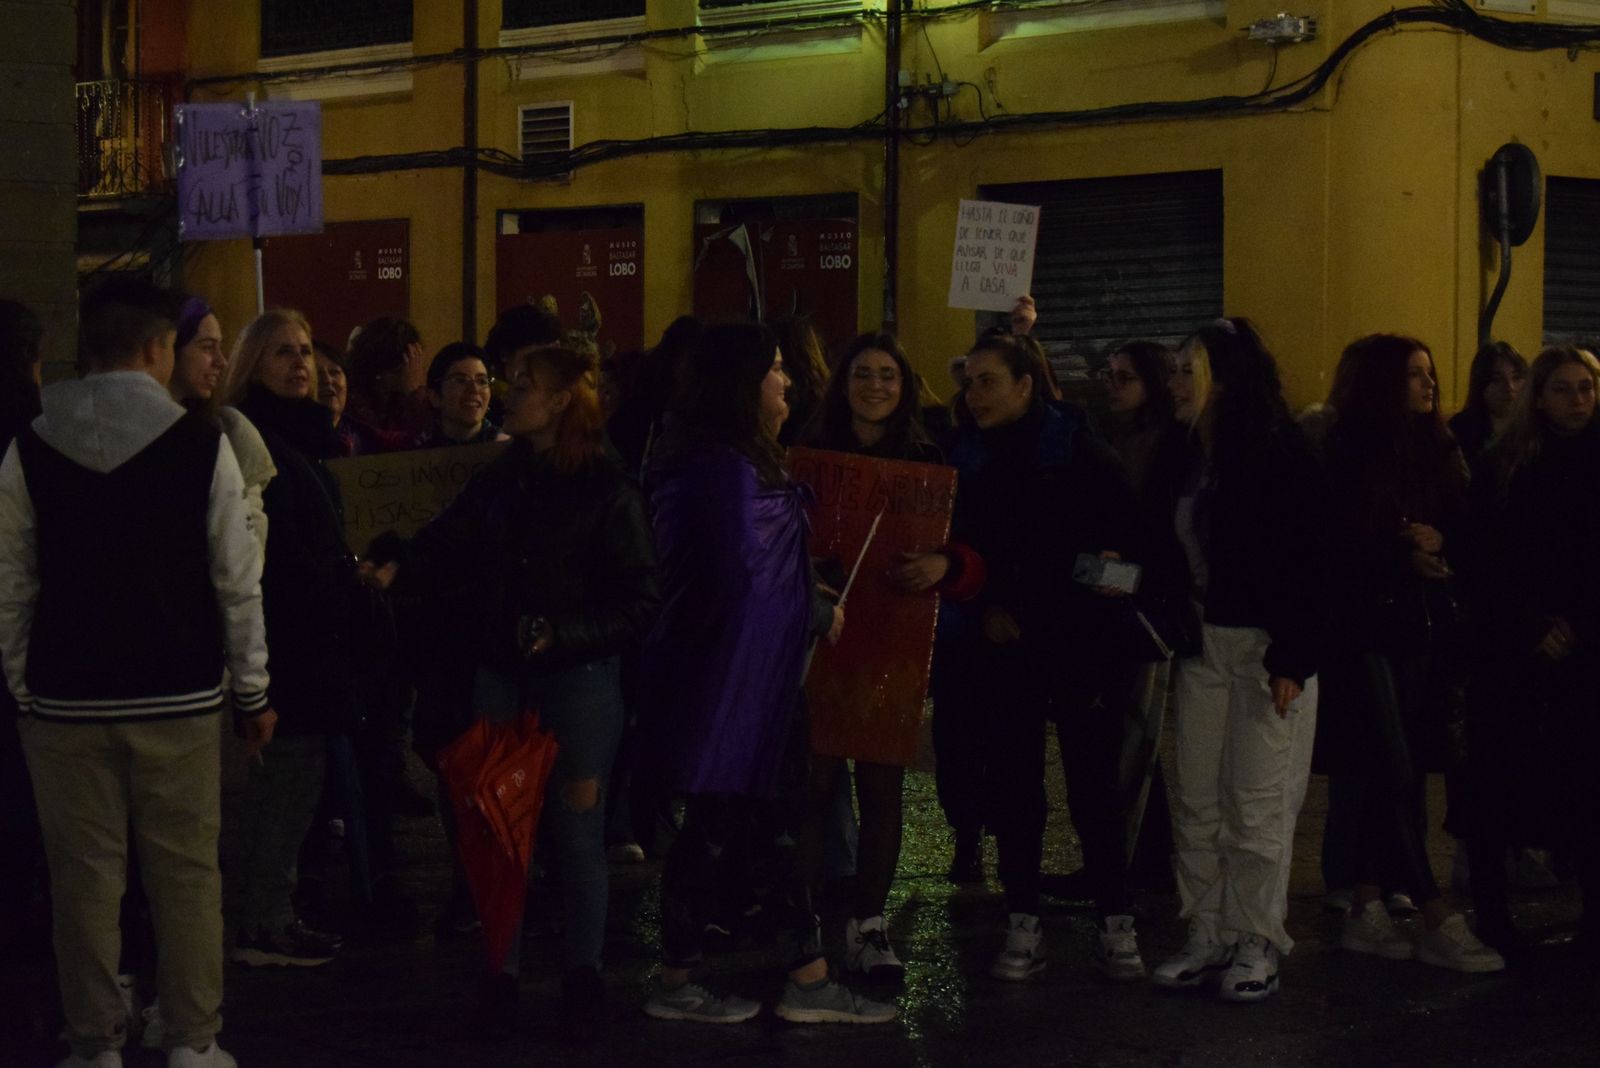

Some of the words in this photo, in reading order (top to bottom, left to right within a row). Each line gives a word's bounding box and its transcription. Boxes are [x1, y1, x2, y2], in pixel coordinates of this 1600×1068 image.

[253, 110, 302, 162] VOZ
[186, 177, 240, 226] CALLA
[961, 206, 992, 223] HASTA
[1008, 230, 1027, 243] QUE
[820, 254, 852, 270] LOBO
[1010, 248, 1027, 262] QUE
[378, 267, 402, 279] LOBO
[609, 262, 637, 276] LOBO
[993, 262, 1018, 277] VIVA
[961, 275, 969, 292] A
